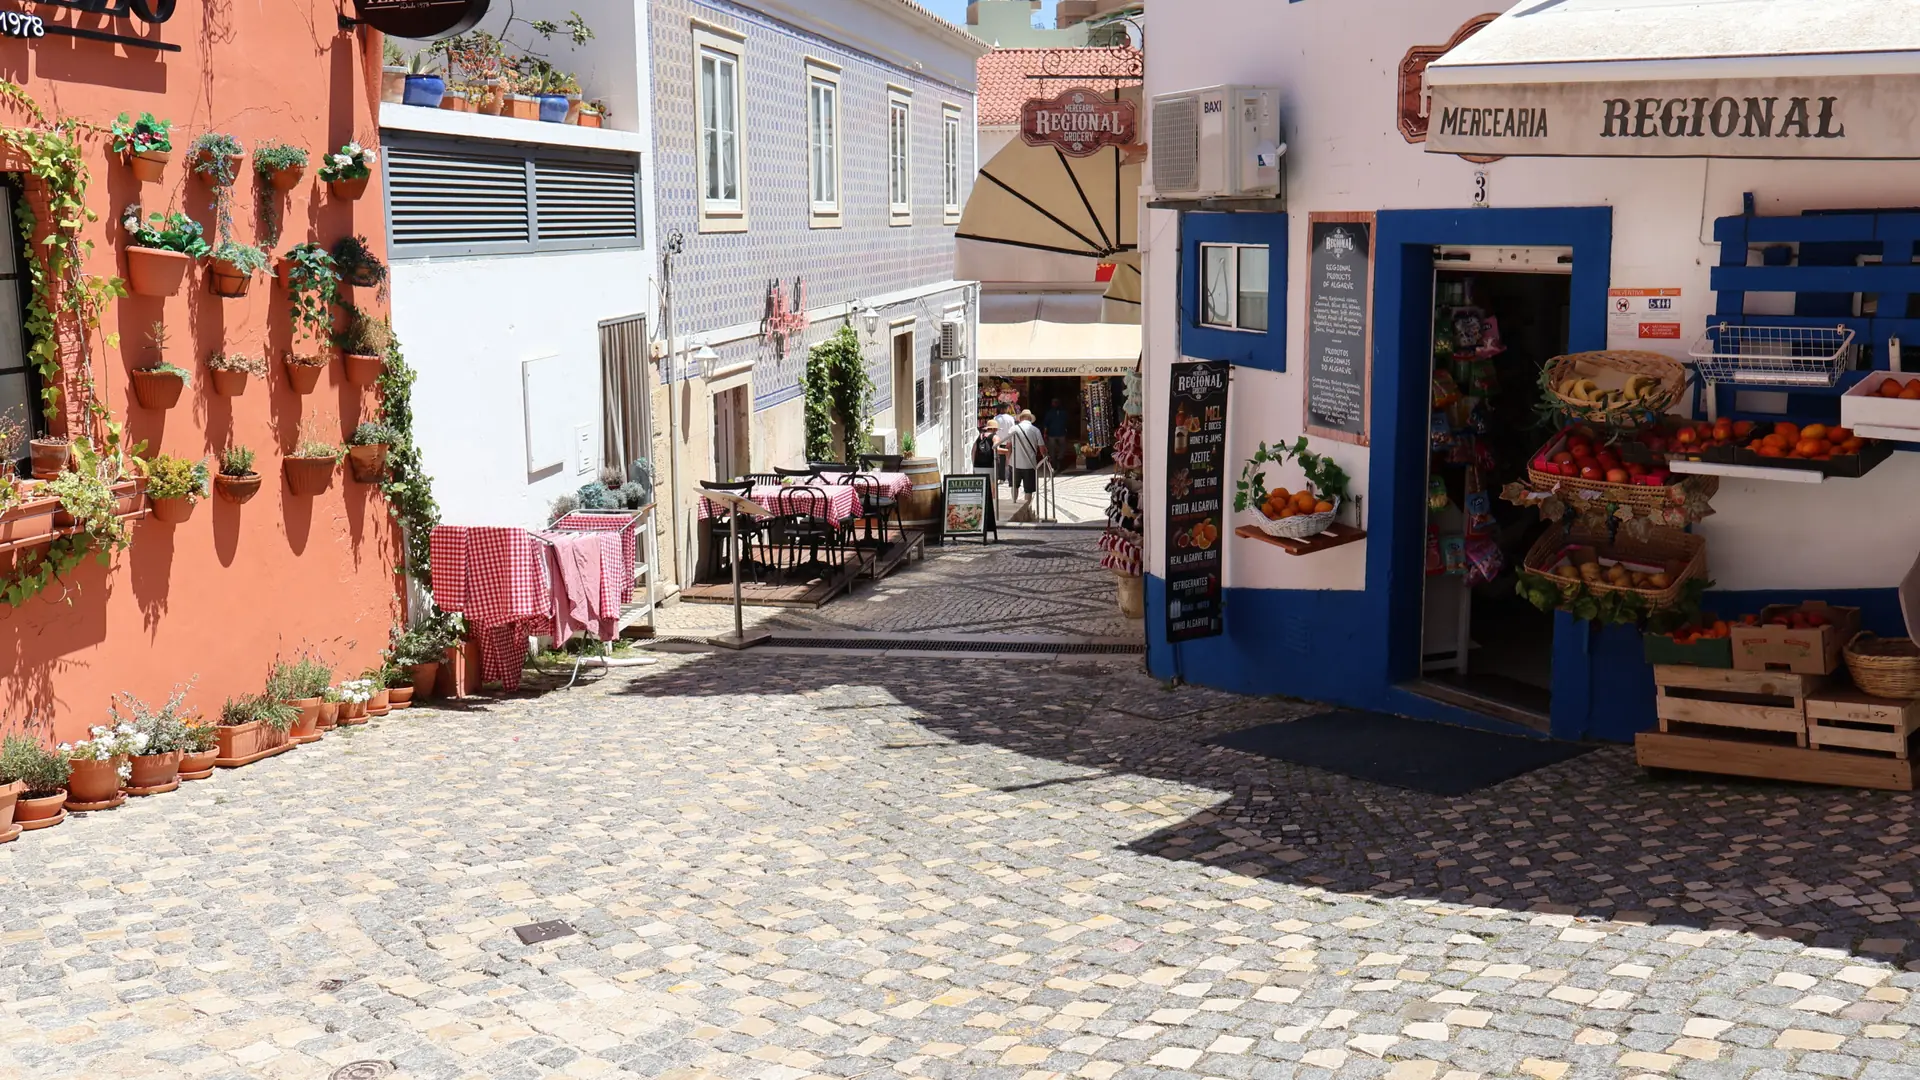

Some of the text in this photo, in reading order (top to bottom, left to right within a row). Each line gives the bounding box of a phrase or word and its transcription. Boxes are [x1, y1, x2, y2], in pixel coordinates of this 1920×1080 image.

[0, 12, 44, 37] 1978
[1064, 104, 1095, 112] MERCEARIA
[1204, 100, 1222, 114] BAXI
[1036, 110, 1124, 135] REGIONAL
[1440, 96, 1846, 138] MERCEARIA REGIONAL
[1064, 132, 1094, 142] GROCERY
[1474, 176, 1486, 202] 3
[1178, 373, 1222, 391] REGIONAL
[1204, 404, 1222, 422] MEL
[1204, 422, 1222, 431] E DOCES
[1190, 436, 1204, 444] HONEY
[1209, 434, 1222, 443] JAMS
[1190, 450, 1211, 464] AZEITE
[1194, 476, 1218, 488] DOCE FINO
[1172, 498, 1218, 516] FRUTA ALGARVIA
[1170, 549, 1217, 565] REAL ALGARVE FRUIT
[1172, 576, 1208, 591] REFRIGERANTES
[1172, 616, 1208, 632] VINHO ALGARVIO
